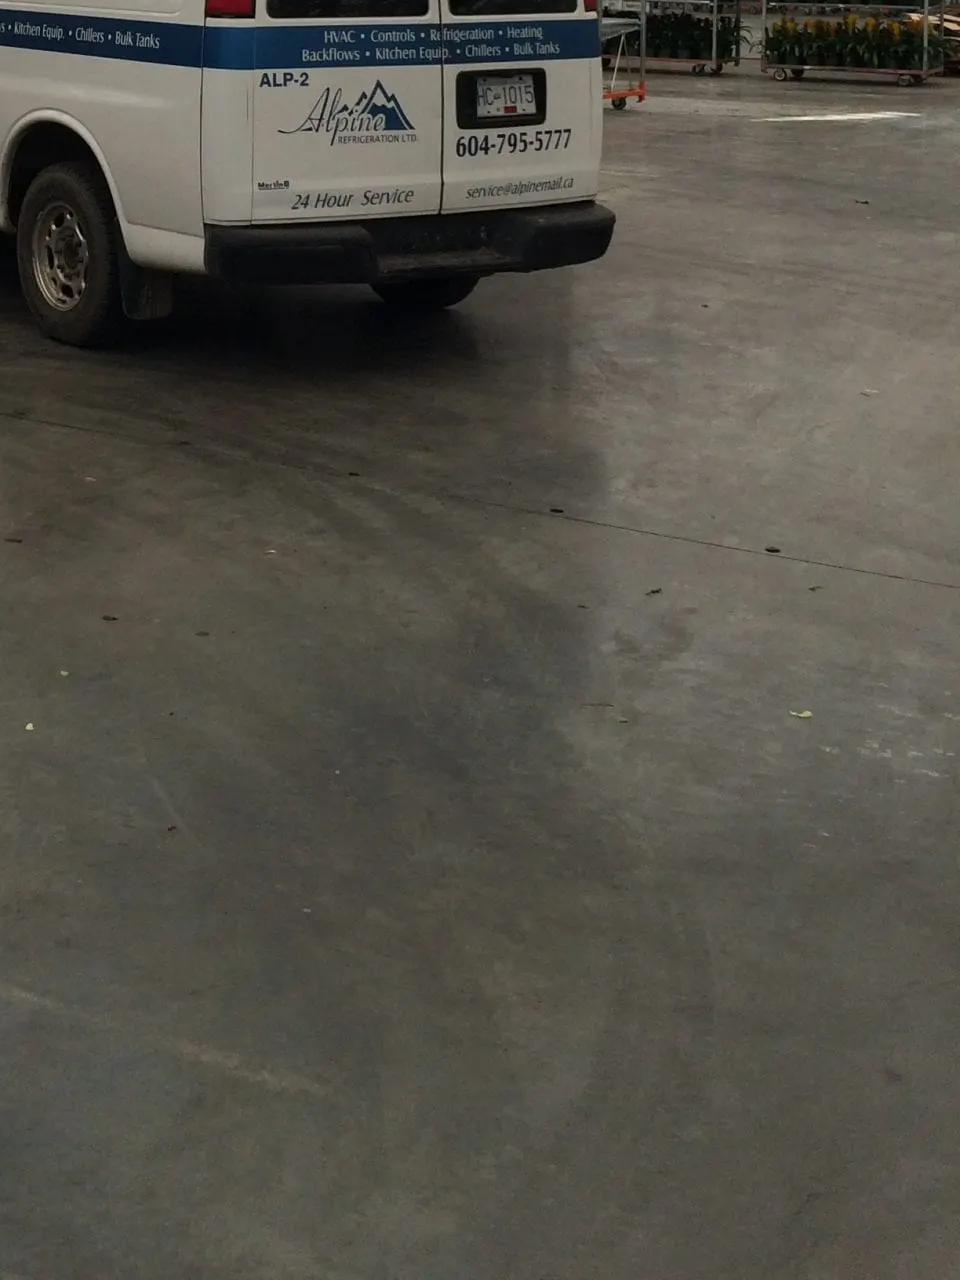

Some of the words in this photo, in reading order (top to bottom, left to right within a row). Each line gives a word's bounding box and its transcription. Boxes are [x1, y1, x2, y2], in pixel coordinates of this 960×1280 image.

[14, 21, 40, 36] Kitchen
[42, 24, 65, 41] Equip.
[75, 27, 105, 43] Chillers
[115, 30, 133, 46] Bulk
[136, 32, 160, 49] Tanks
[324, 30, 356, 43] HVAC
[370, 28, 416, 42] Controls
[429, 26, 495, 43] Refrigeration
[507, 26, 543, 40] Heating
[302, 47, 361, 62] Backflows
[375, 46, 417, 60] Kitchen
[419, 46, 452, 60] Equip.
[465, 43, 501, 57] Chillers
[513, 41, 534, 55] Bulk
[535, 40, 560, 54] Tanks
[259, 72, 309, 88] ALP-2
[277, 86, 385, 146] Alpine
[338, 134, 399, 145] REFRIGERATION
[456, 128, 572, 158] 604-795-5777
[465, 176, 574, 199] service@alpinemail.ca
[291, 193, 310, 210] 24
[314, 192, 354, 209] Hour
[361, 188, 414, 207] Service
